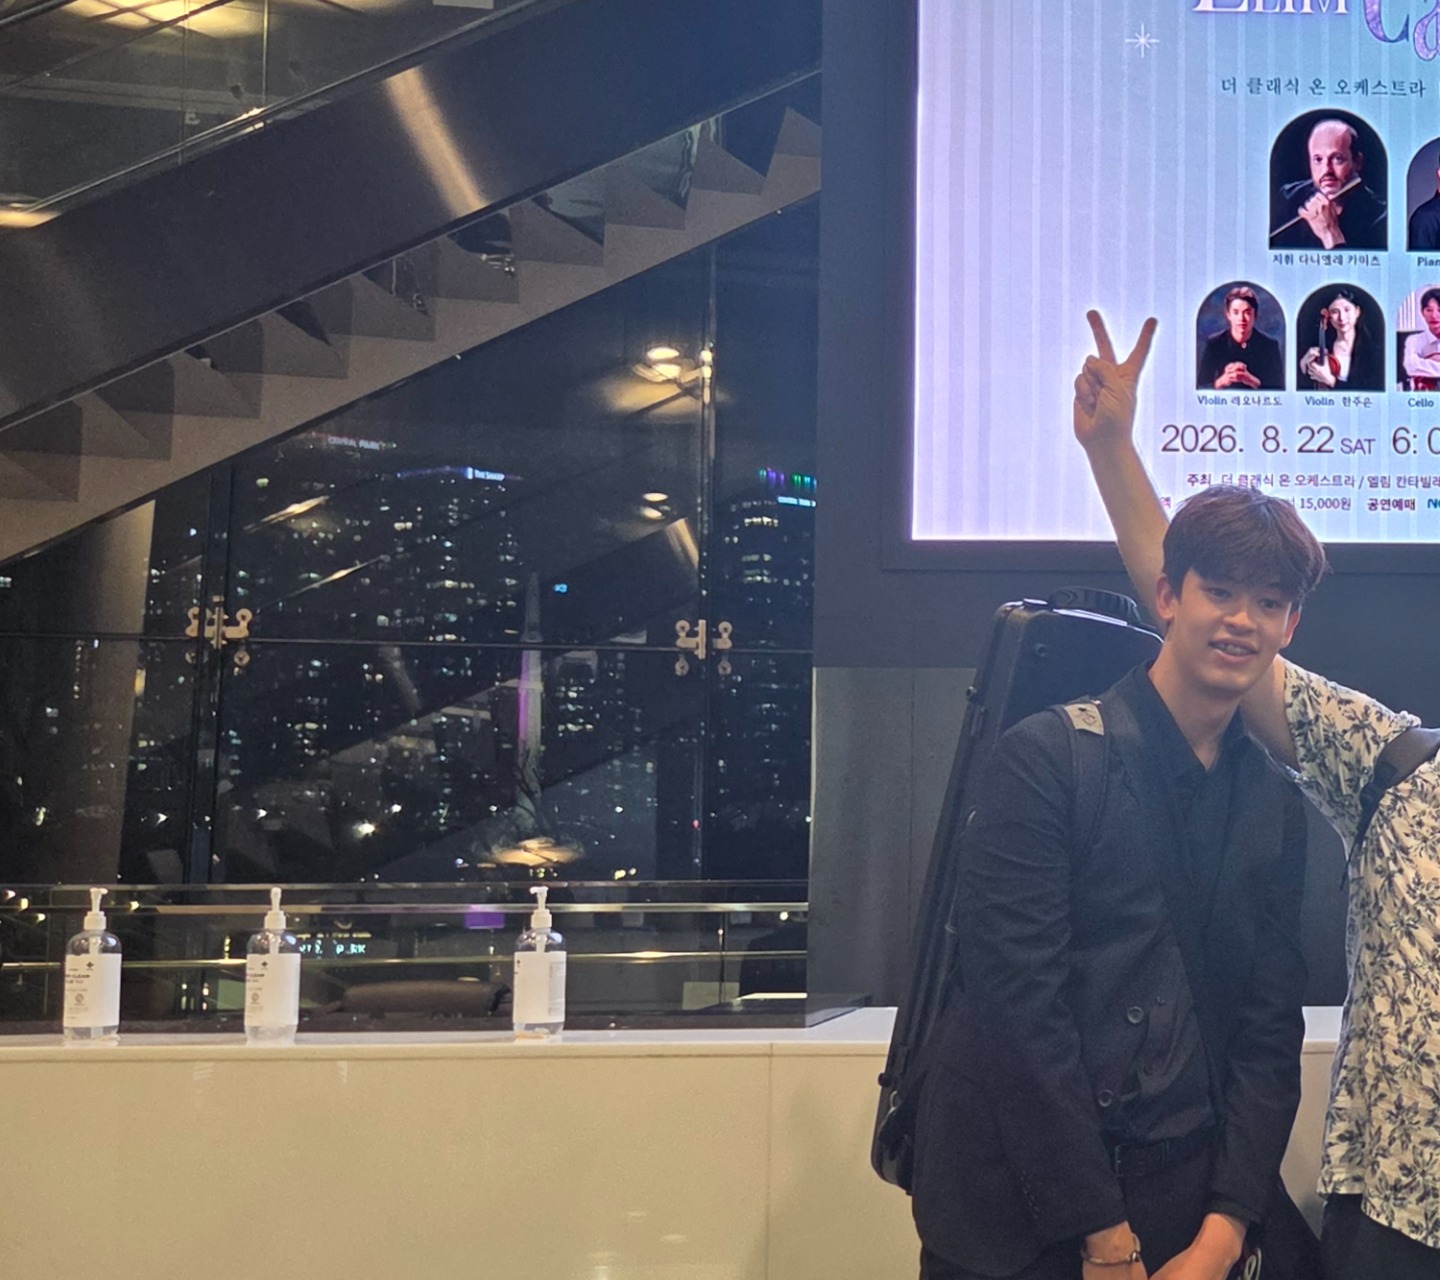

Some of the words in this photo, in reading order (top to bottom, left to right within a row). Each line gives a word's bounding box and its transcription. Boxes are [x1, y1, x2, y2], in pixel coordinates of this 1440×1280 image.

[1221, 76, 1236, 94] 더
[1246, 76, 1299, 95] 클래식
[1309, 78, 1326, 96] 온
[1334, 78, 1426, 98] 오케스트라
[1197, 396, 1227, 406] Violin
[1305, 396, 1335, 406] Violin
[1408, 398, 1434, 408] Cello
[1161, 424, 1244, 453] 2026.
[1261, 426, 1288, 454] 8.
[1297, 426, 1335, 453] 22
[1340, 439, 1376, 455] SAT
[1187, 473, 1211, 487] 주최
[1279, 474, 1290, 487] 온
[1294, 474, 1355, 489] 오케스트라
[1368, 475, 1391, 489] 엘림
[1300, 497, 1351, 511] 15,000원
[1367, 498, 1416, 511] 공연예매
